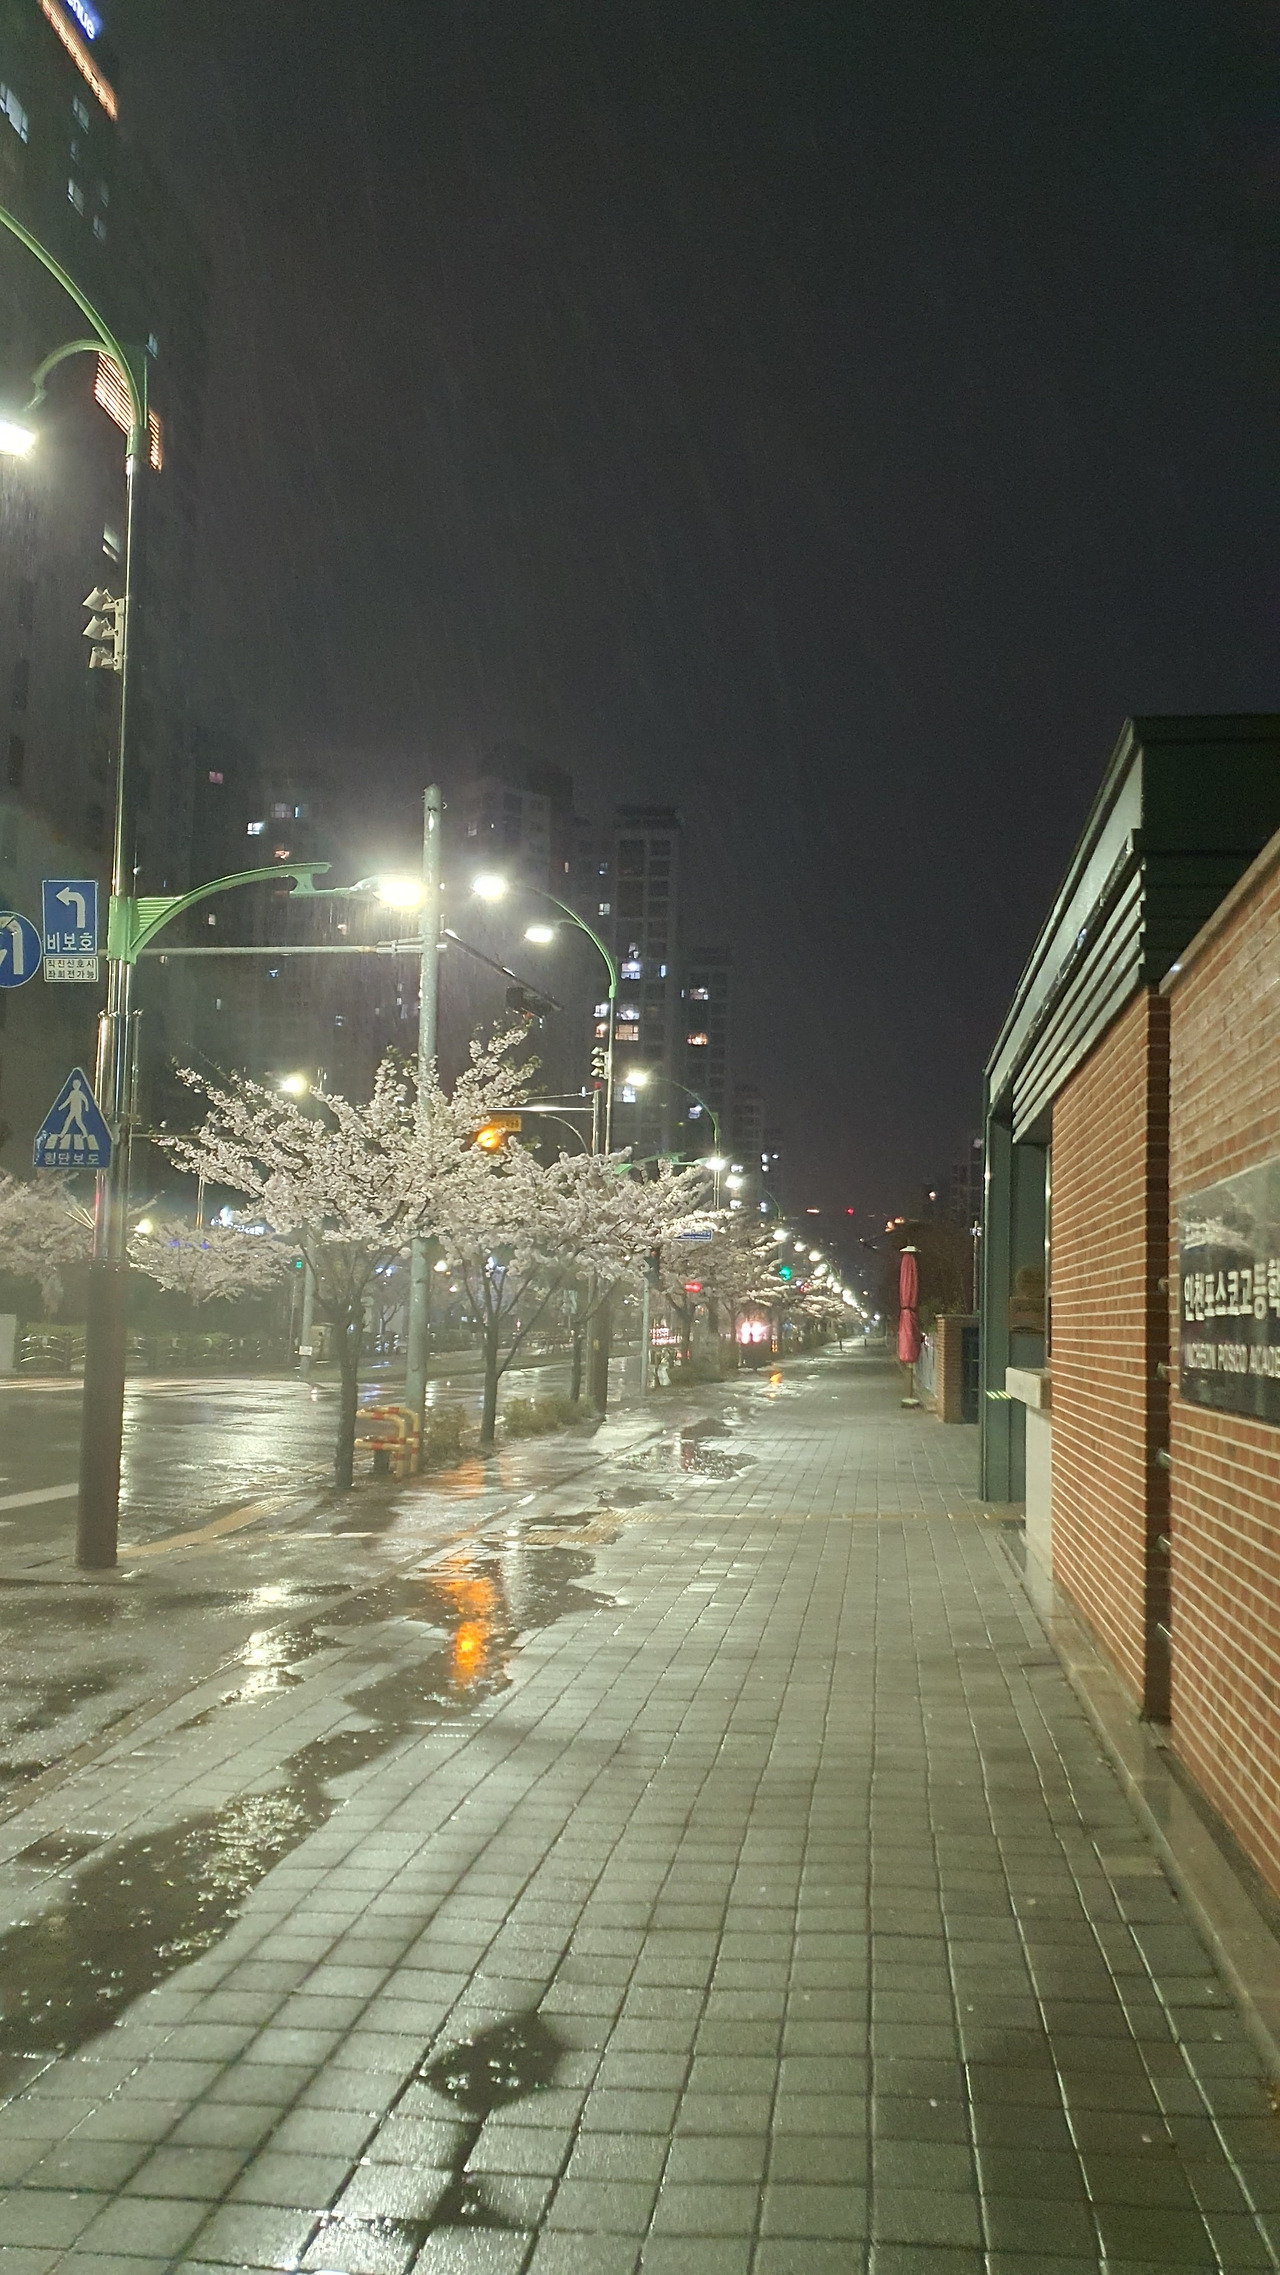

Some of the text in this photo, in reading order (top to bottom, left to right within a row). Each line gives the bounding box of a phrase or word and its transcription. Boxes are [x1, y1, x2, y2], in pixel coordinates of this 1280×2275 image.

[47, 931, 94, 953] 비보호
[44, 1152, 100, 1166] 횡단보도
[1217, 1344, 1248, 1373] POSCO
